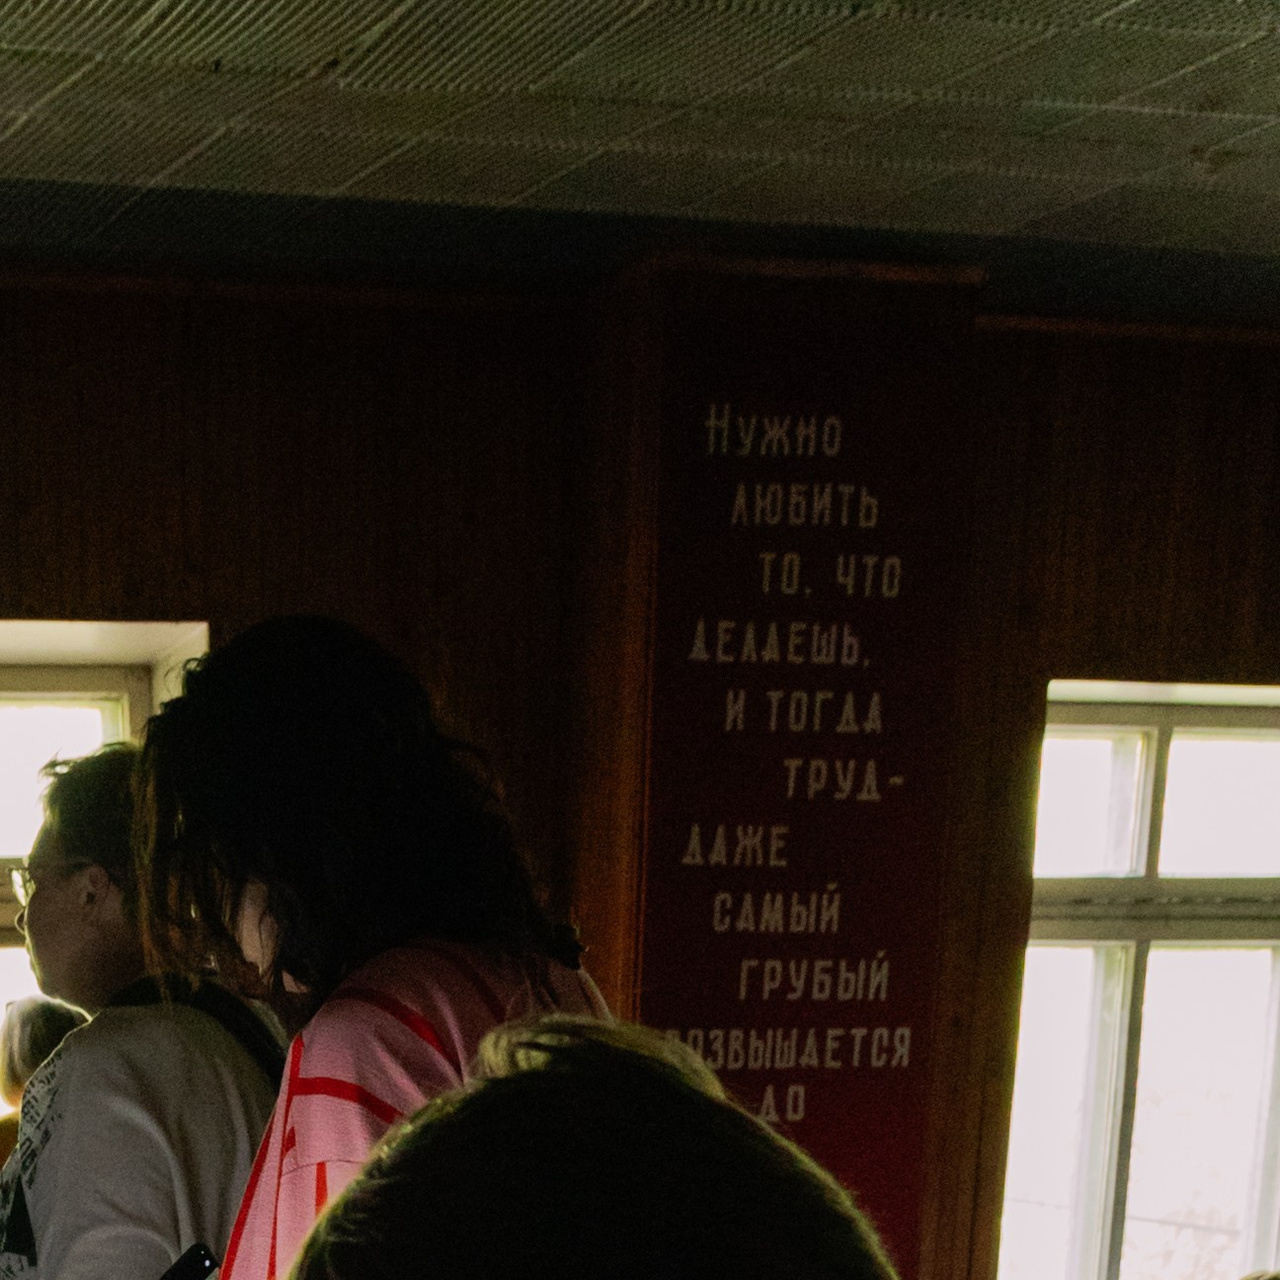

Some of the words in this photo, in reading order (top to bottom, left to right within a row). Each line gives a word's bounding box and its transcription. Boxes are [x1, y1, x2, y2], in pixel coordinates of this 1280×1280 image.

[731, 483, 879, 528] ЛЮБИТЬ
[836, 555, 902, 598] ЧТО
[725, 690, 746, 732] И
[767, 690, 883, 734] ТОГДА
[681, 824, 789, 868] ДАЖЕ
[713, 883, 841, 934] САМЫЙ
[739, 950, 890, 1001] ГРУБЫЙ
[665, 1026, 912, 1070] ОЗВЫШАЕТСЯ
[759, 1084, 806, 1124] ДО
